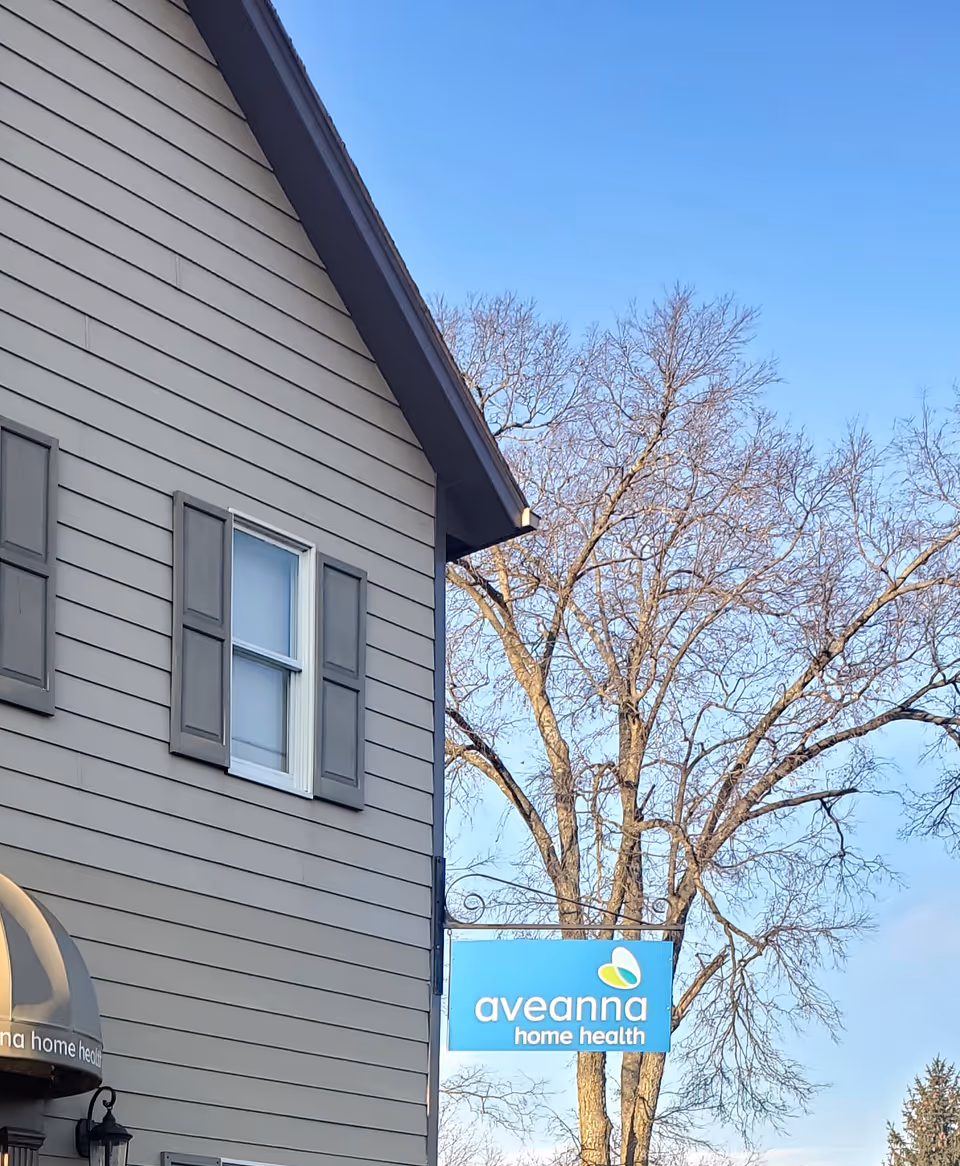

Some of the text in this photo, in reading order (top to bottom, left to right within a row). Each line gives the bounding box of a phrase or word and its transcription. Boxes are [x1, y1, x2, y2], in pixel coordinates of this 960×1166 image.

[474, 995, 648, 1022] aveanna
[31, 1030, 76, 1058] home
[514, 1026, 646, 1046] home health
